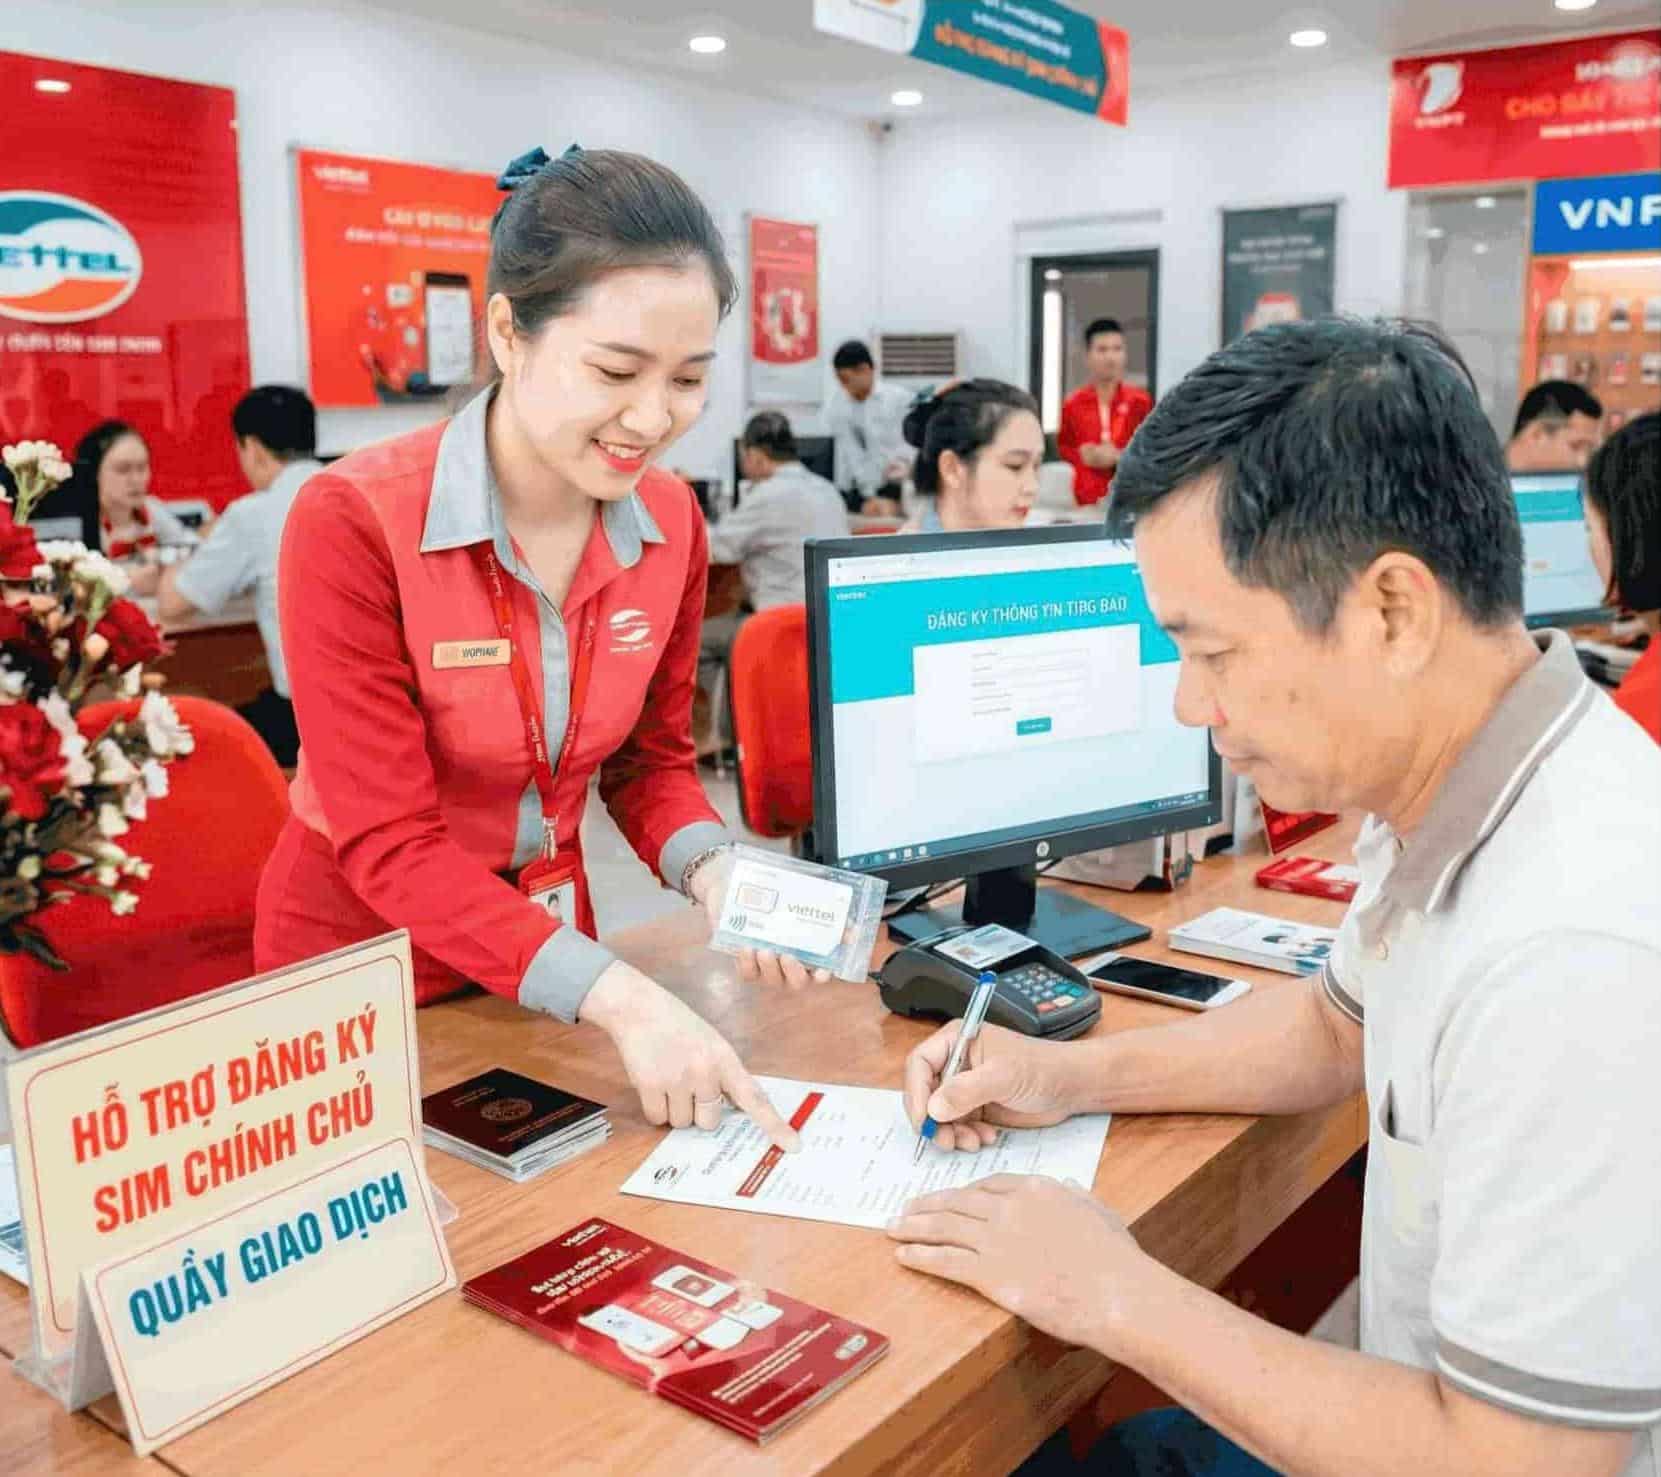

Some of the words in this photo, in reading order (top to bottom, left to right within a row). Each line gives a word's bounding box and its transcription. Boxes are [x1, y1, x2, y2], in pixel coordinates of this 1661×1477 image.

[71, 1081, 129, 1165] HỖ
[139, 1063, 217, 1137] TRỢ
[227, 1030, 327, 1105] ĐĂNG
[335, 1001, 378, 1064] KÝ
[93, 1162, 173, 1234] SIM
[183, 1113, 298, 1198] CHÍNH
[306, 1069, 375, 1147] CHỦ
[128, 1248, 228, 1337] QUẦY
[238, 1211, 323, 1284] GIAO
[327, 1170, 408, 1241] DỊCH
